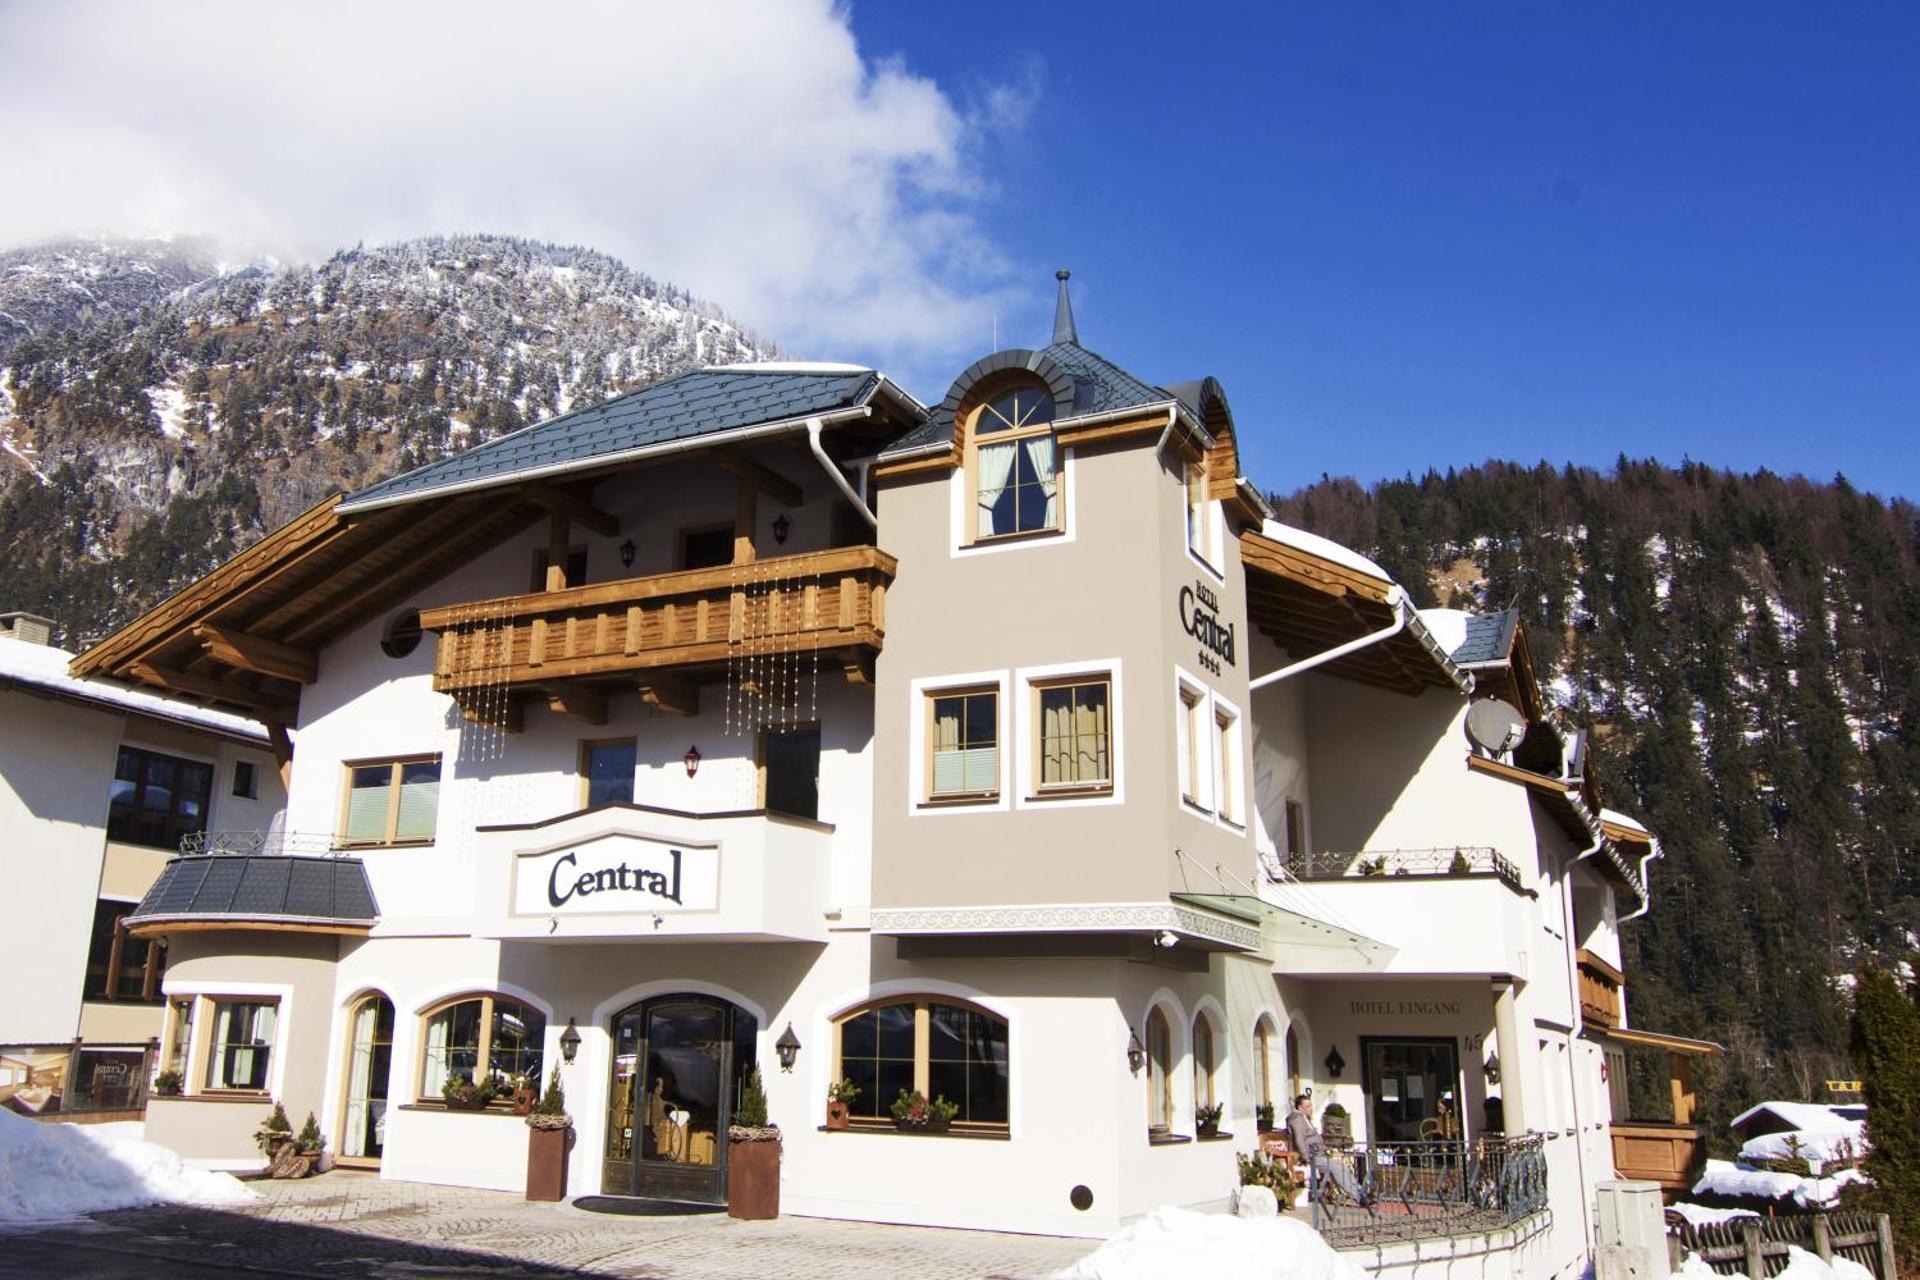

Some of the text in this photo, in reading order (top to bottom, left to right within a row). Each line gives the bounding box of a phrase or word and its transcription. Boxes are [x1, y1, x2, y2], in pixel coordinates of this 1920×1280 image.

[1179, 586, 1235, 667] Central
[548, 849, 682, 907] Central
[1351, 1001, 1461, 1015] HOTEL EINGANG
